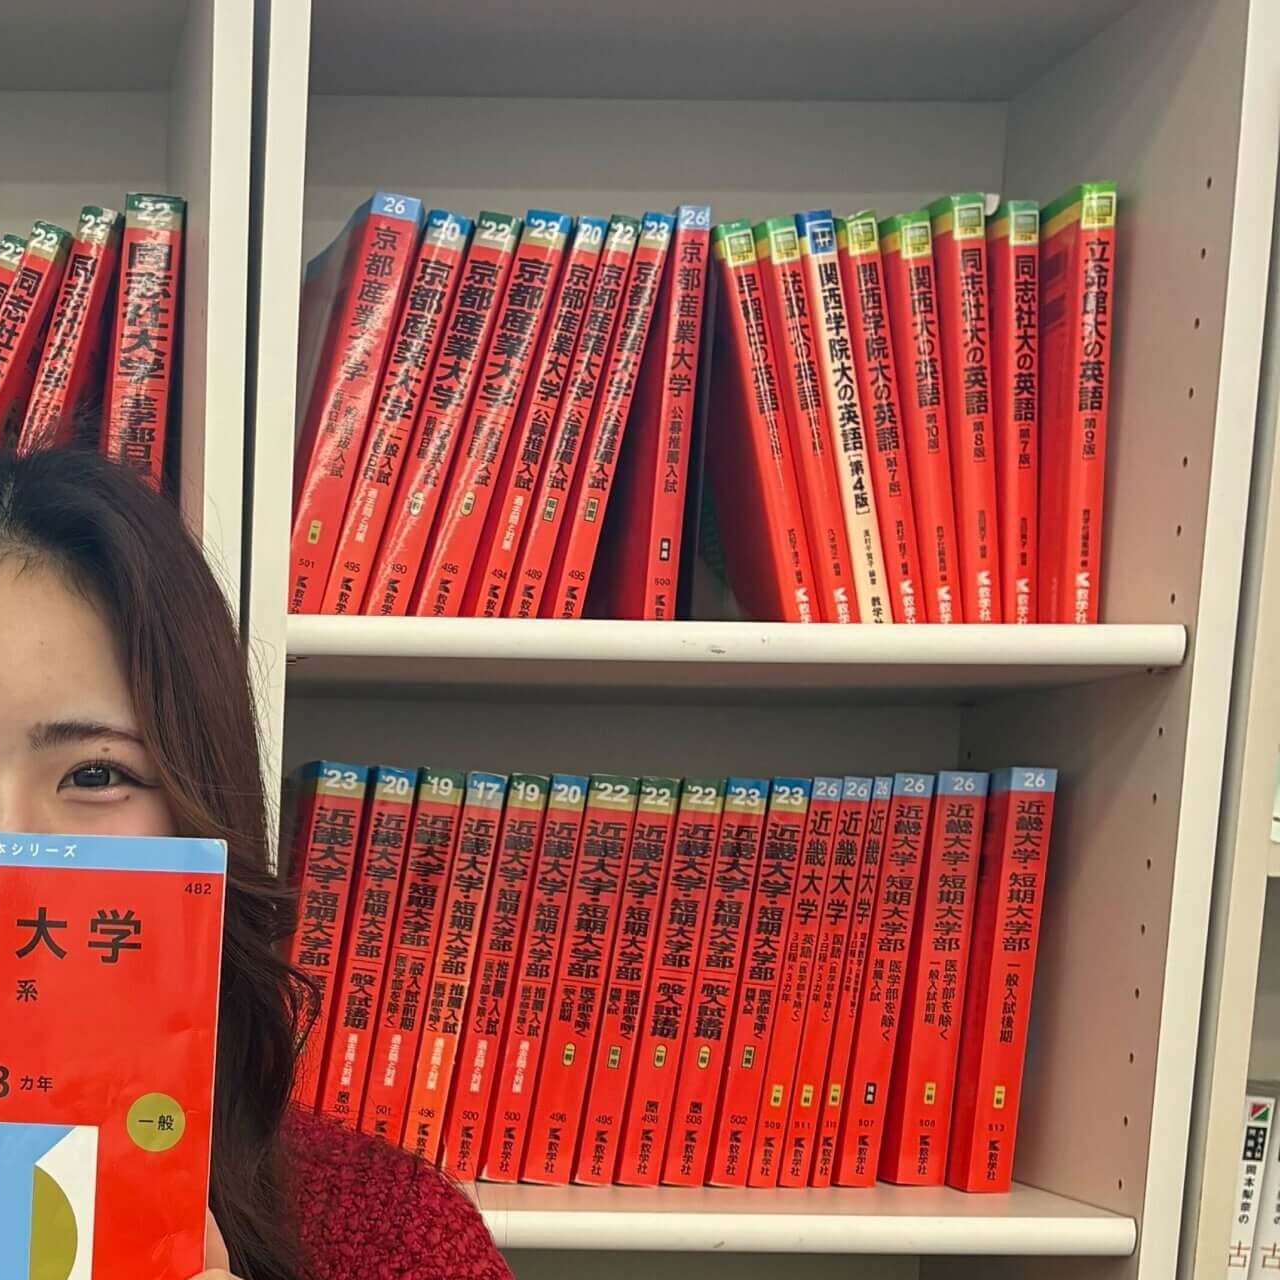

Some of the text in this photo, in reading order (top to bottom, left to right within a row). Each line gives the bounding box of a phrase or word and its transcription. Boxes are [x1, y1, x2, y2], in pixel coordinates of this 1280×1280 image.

[538, 264, 593, 402] 京都産業大学
[669, 238, 705, 397] 京都産業大学
[857, 263, 899, 451] 関西学院大の英語
[909, 266, 940, 406] 関西大の英語
[961, 247, 988, 415] 同志社大の英語
[1013, 254, 1035, 421] 同志社大の英語
[1079, 238, 1109, 411] 立命館大の英語
[324, 769, 357, 789] '23
[382, 775, 409, 795] '20
[427, 775, 453, 795] '19
[554, 783, 581, 803] '20
[595, 782, 630, 803] '22
[688, 785, 717, 805] '22
[732, 787, 760, 807] '23
[775, 785, 804, 805] '23
[184, 882, 212, 895] 482
[876, 804, 924, 952] 近畿大学・短期大学部
[932, 804, 974, 951] 近畿大学・短期大学部
[1001, 800, 1045, 952] 近畿大学・短期大学部
[138, 1114, 174, 1132] 一般
